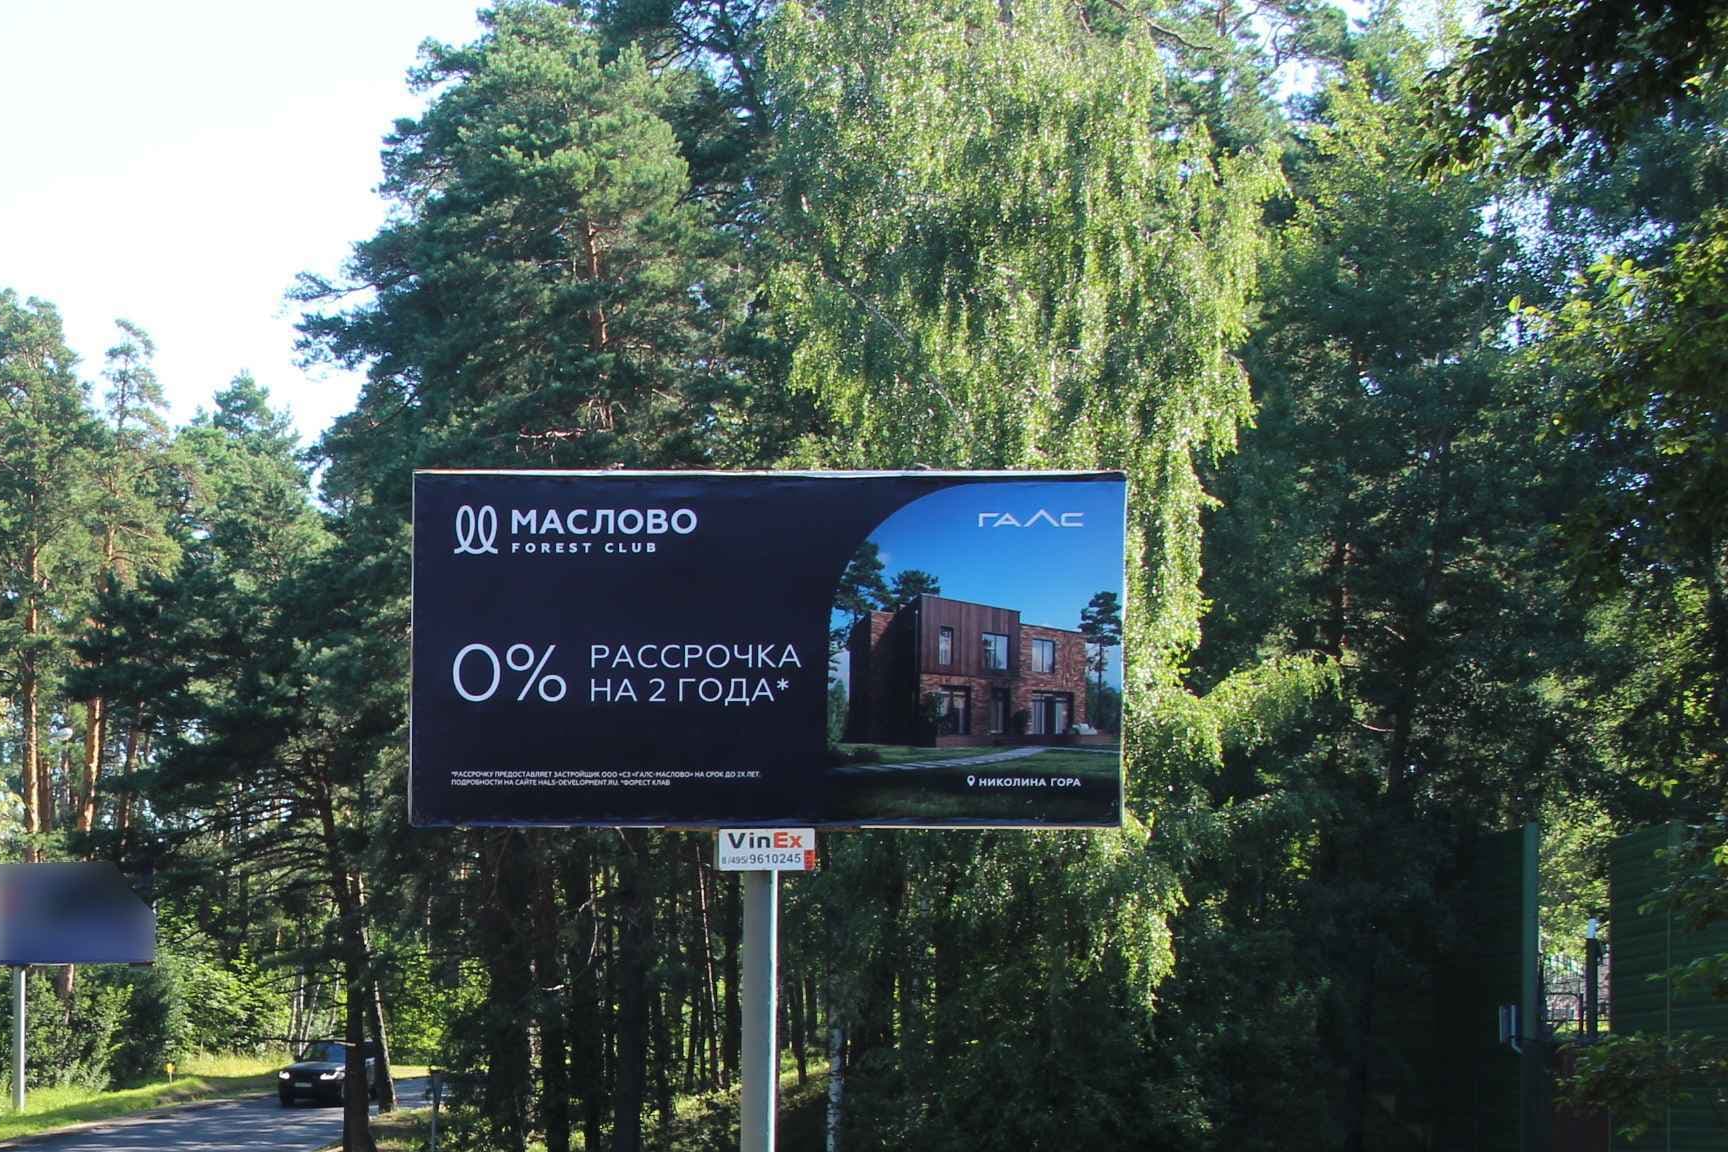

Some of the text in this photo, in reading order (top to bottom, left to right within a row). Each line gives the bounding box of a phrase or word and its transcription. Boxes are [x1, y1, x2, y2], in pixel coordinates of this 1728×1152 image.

[511, 508, 698, 535] МАСЛОВО
[978, 509, 1085, 527] ГАЛС
[511, 542, 656, 554] FOREST CLUB
[591, 643, 802, 669] РАССРОЧКА
[452, 643, 567, 702] 0%
[590, 678, 638, 702] НА
[648, 678, 666, 702] 2
[978, 777, 1082, 787] НИКОЛИНА ГОРА
[728, 832, 803, 848] VinEx
[749, 853, 801, 864] 9610245
